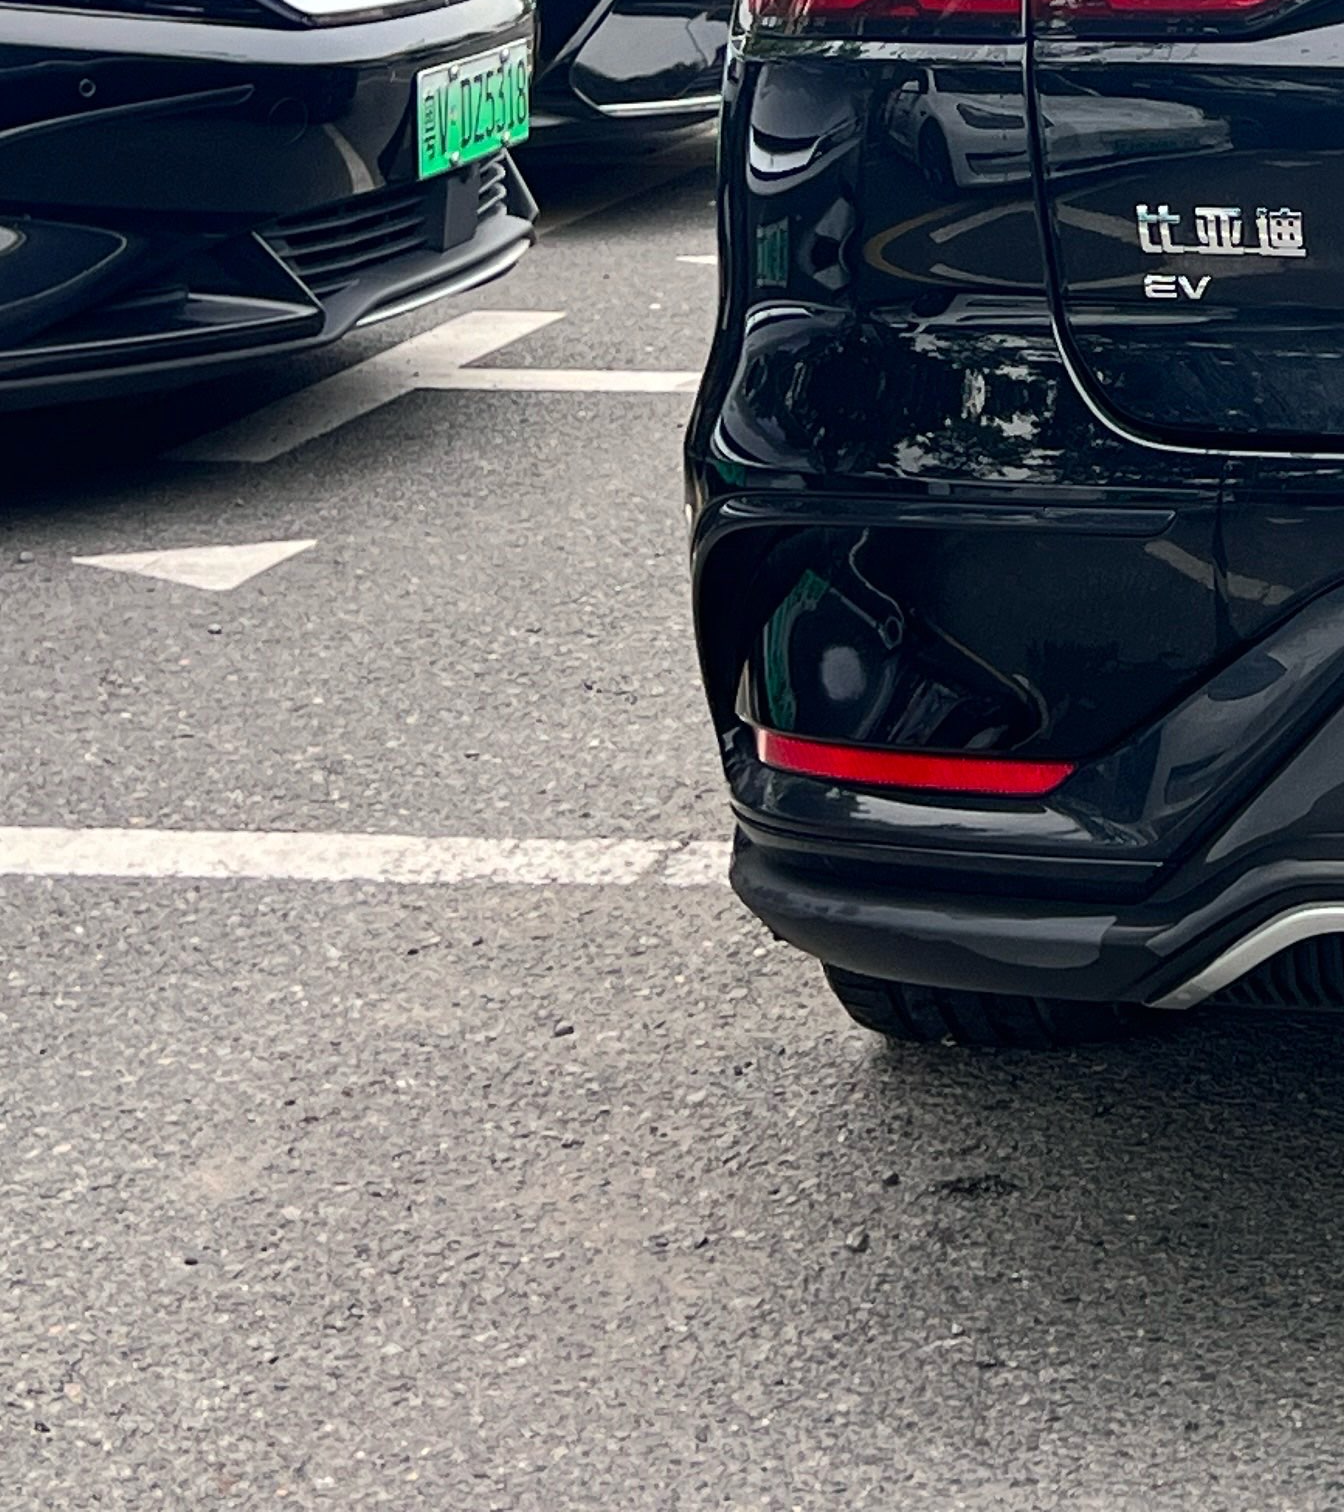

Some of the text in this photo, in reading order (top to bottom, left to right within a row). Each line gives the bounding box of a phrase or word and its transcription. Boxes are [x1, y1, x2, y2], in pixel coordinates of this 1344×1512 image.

[1135, 204, 1307, 258] 比亚迪
[1143, 274, 1212, 300] EV
